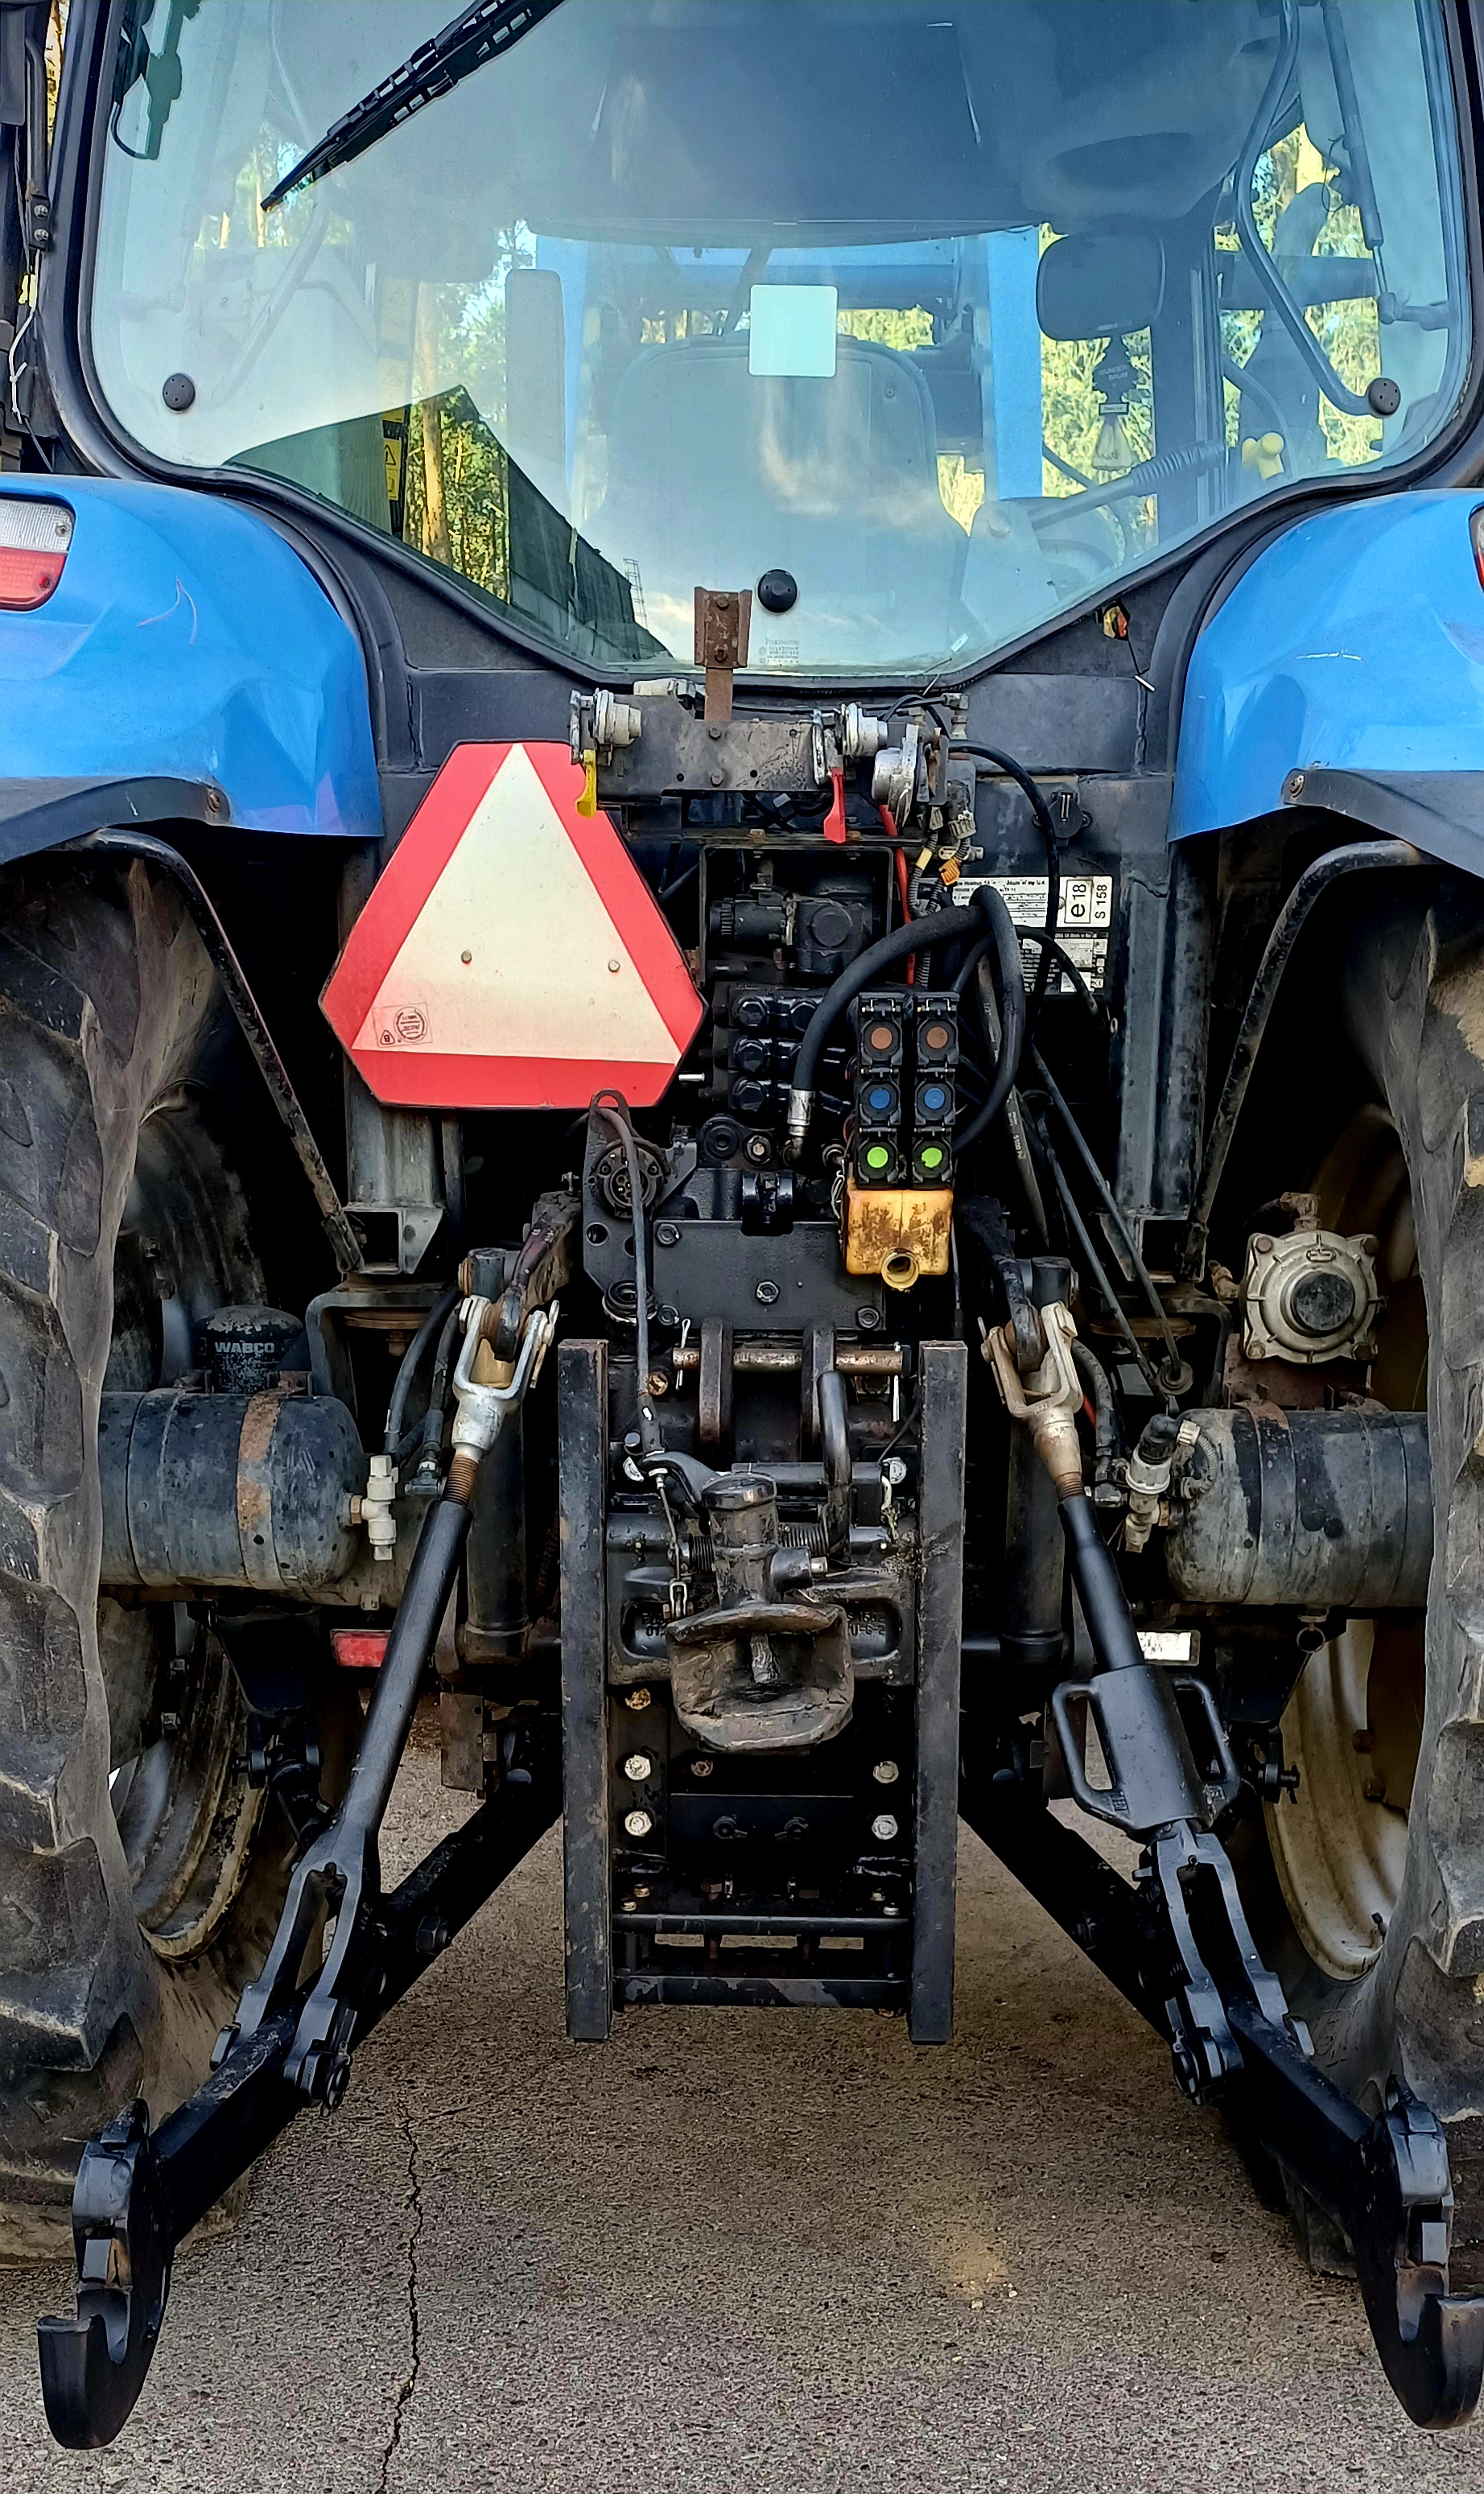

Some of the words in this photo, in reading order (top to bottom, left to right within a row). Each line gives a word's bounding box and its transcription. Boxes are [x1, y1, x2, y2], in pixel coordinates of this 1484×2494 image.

[1095, 884, 1107, 906] 158
[1094, 911, 1106, 919] S
[214, 1342, 275, 1354] WABCO
